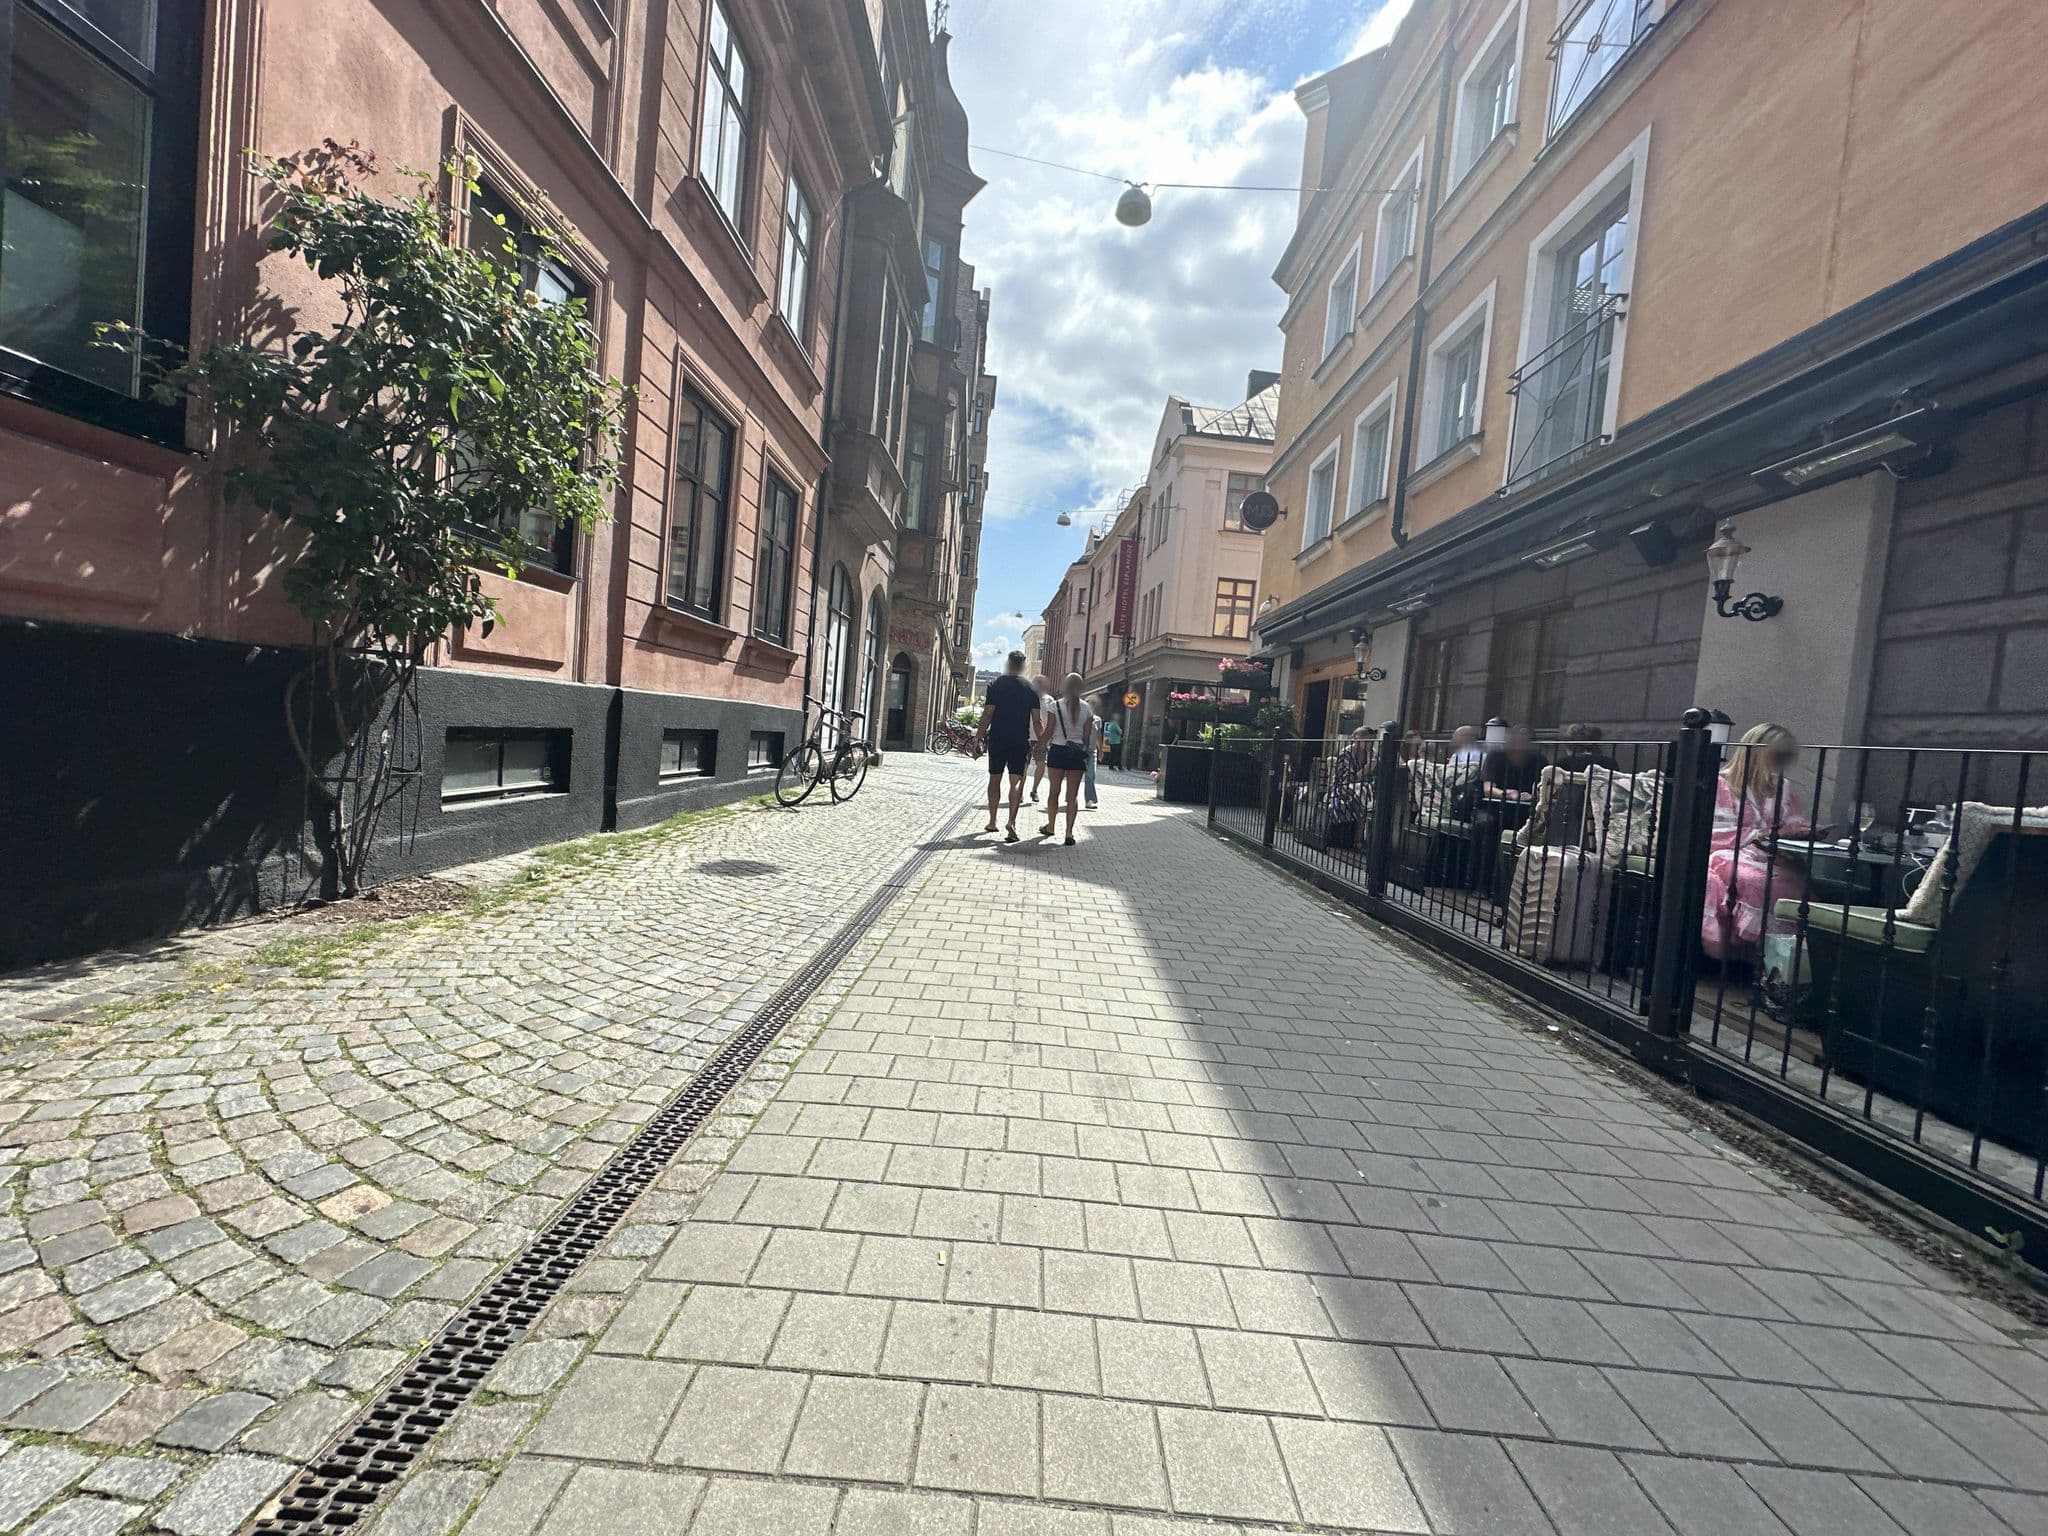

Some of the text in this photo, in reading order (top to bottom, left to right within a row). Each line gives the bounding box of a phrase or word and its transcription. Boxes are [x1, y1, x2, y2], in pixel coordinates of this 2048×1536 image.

[1119, 544, 1133, 633] ELITE HOTEL ESPLANADE
